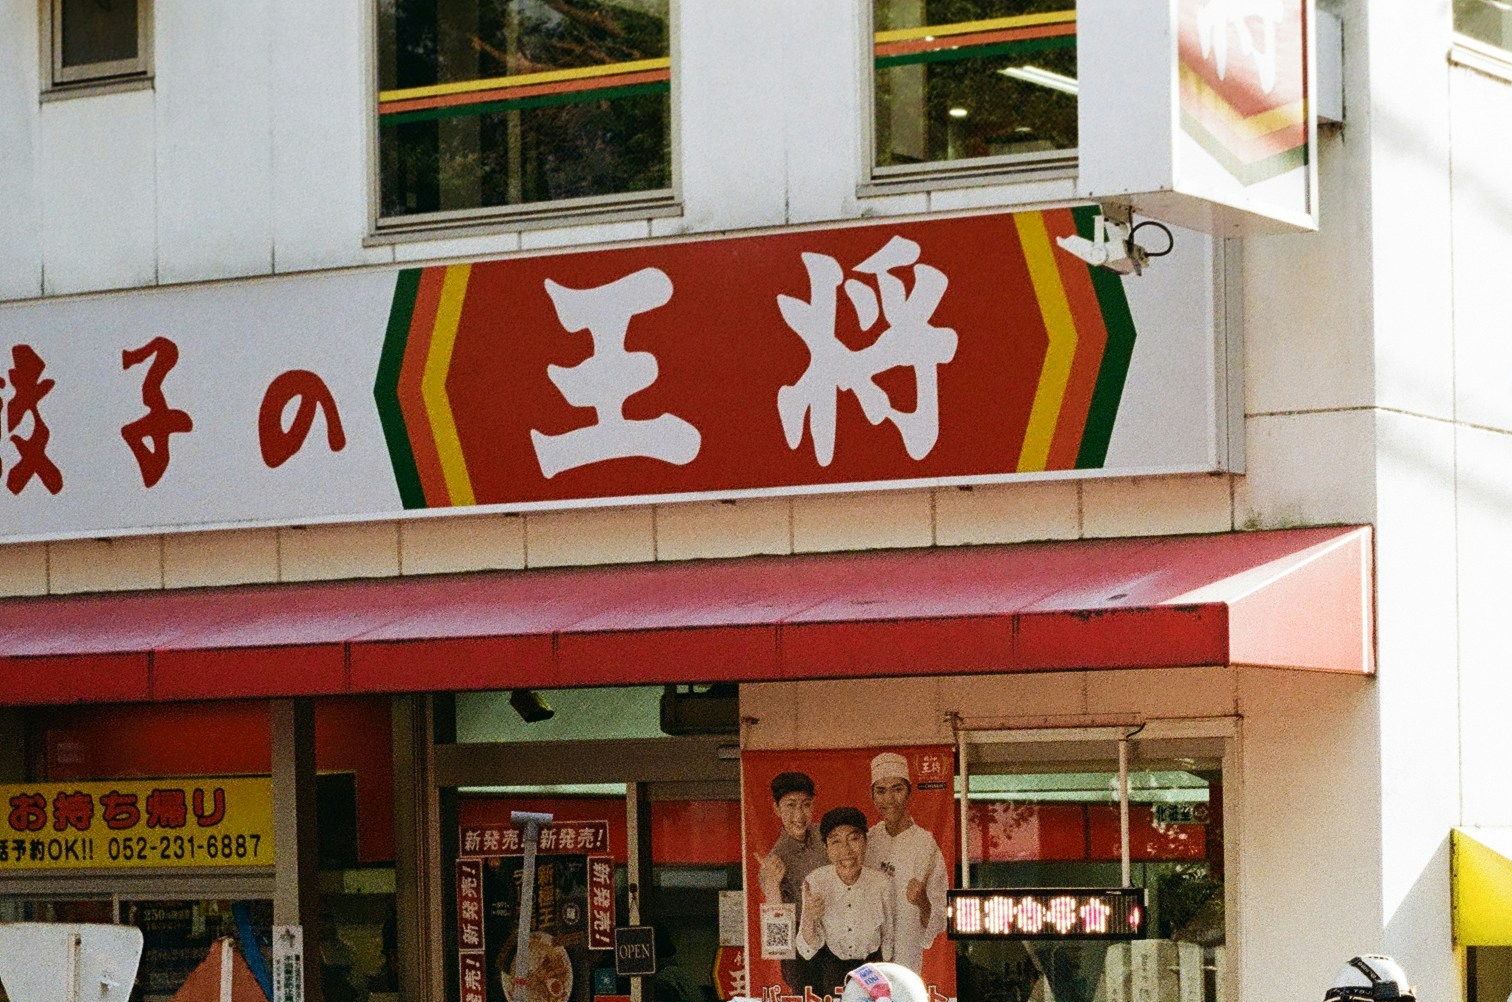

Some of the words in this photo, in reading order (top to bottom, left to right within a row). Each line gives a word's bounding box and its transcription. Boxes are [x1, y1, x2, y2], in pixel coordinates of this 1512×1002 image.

[531, 236, 958, 480] 王将
[8, 788, 226, 832] お持ち帰り
[108, 833, 262, 861] 052-231-6887
[540, 827, 604, 850] 新発売!
[619, 943, 650, 959] OPEN
